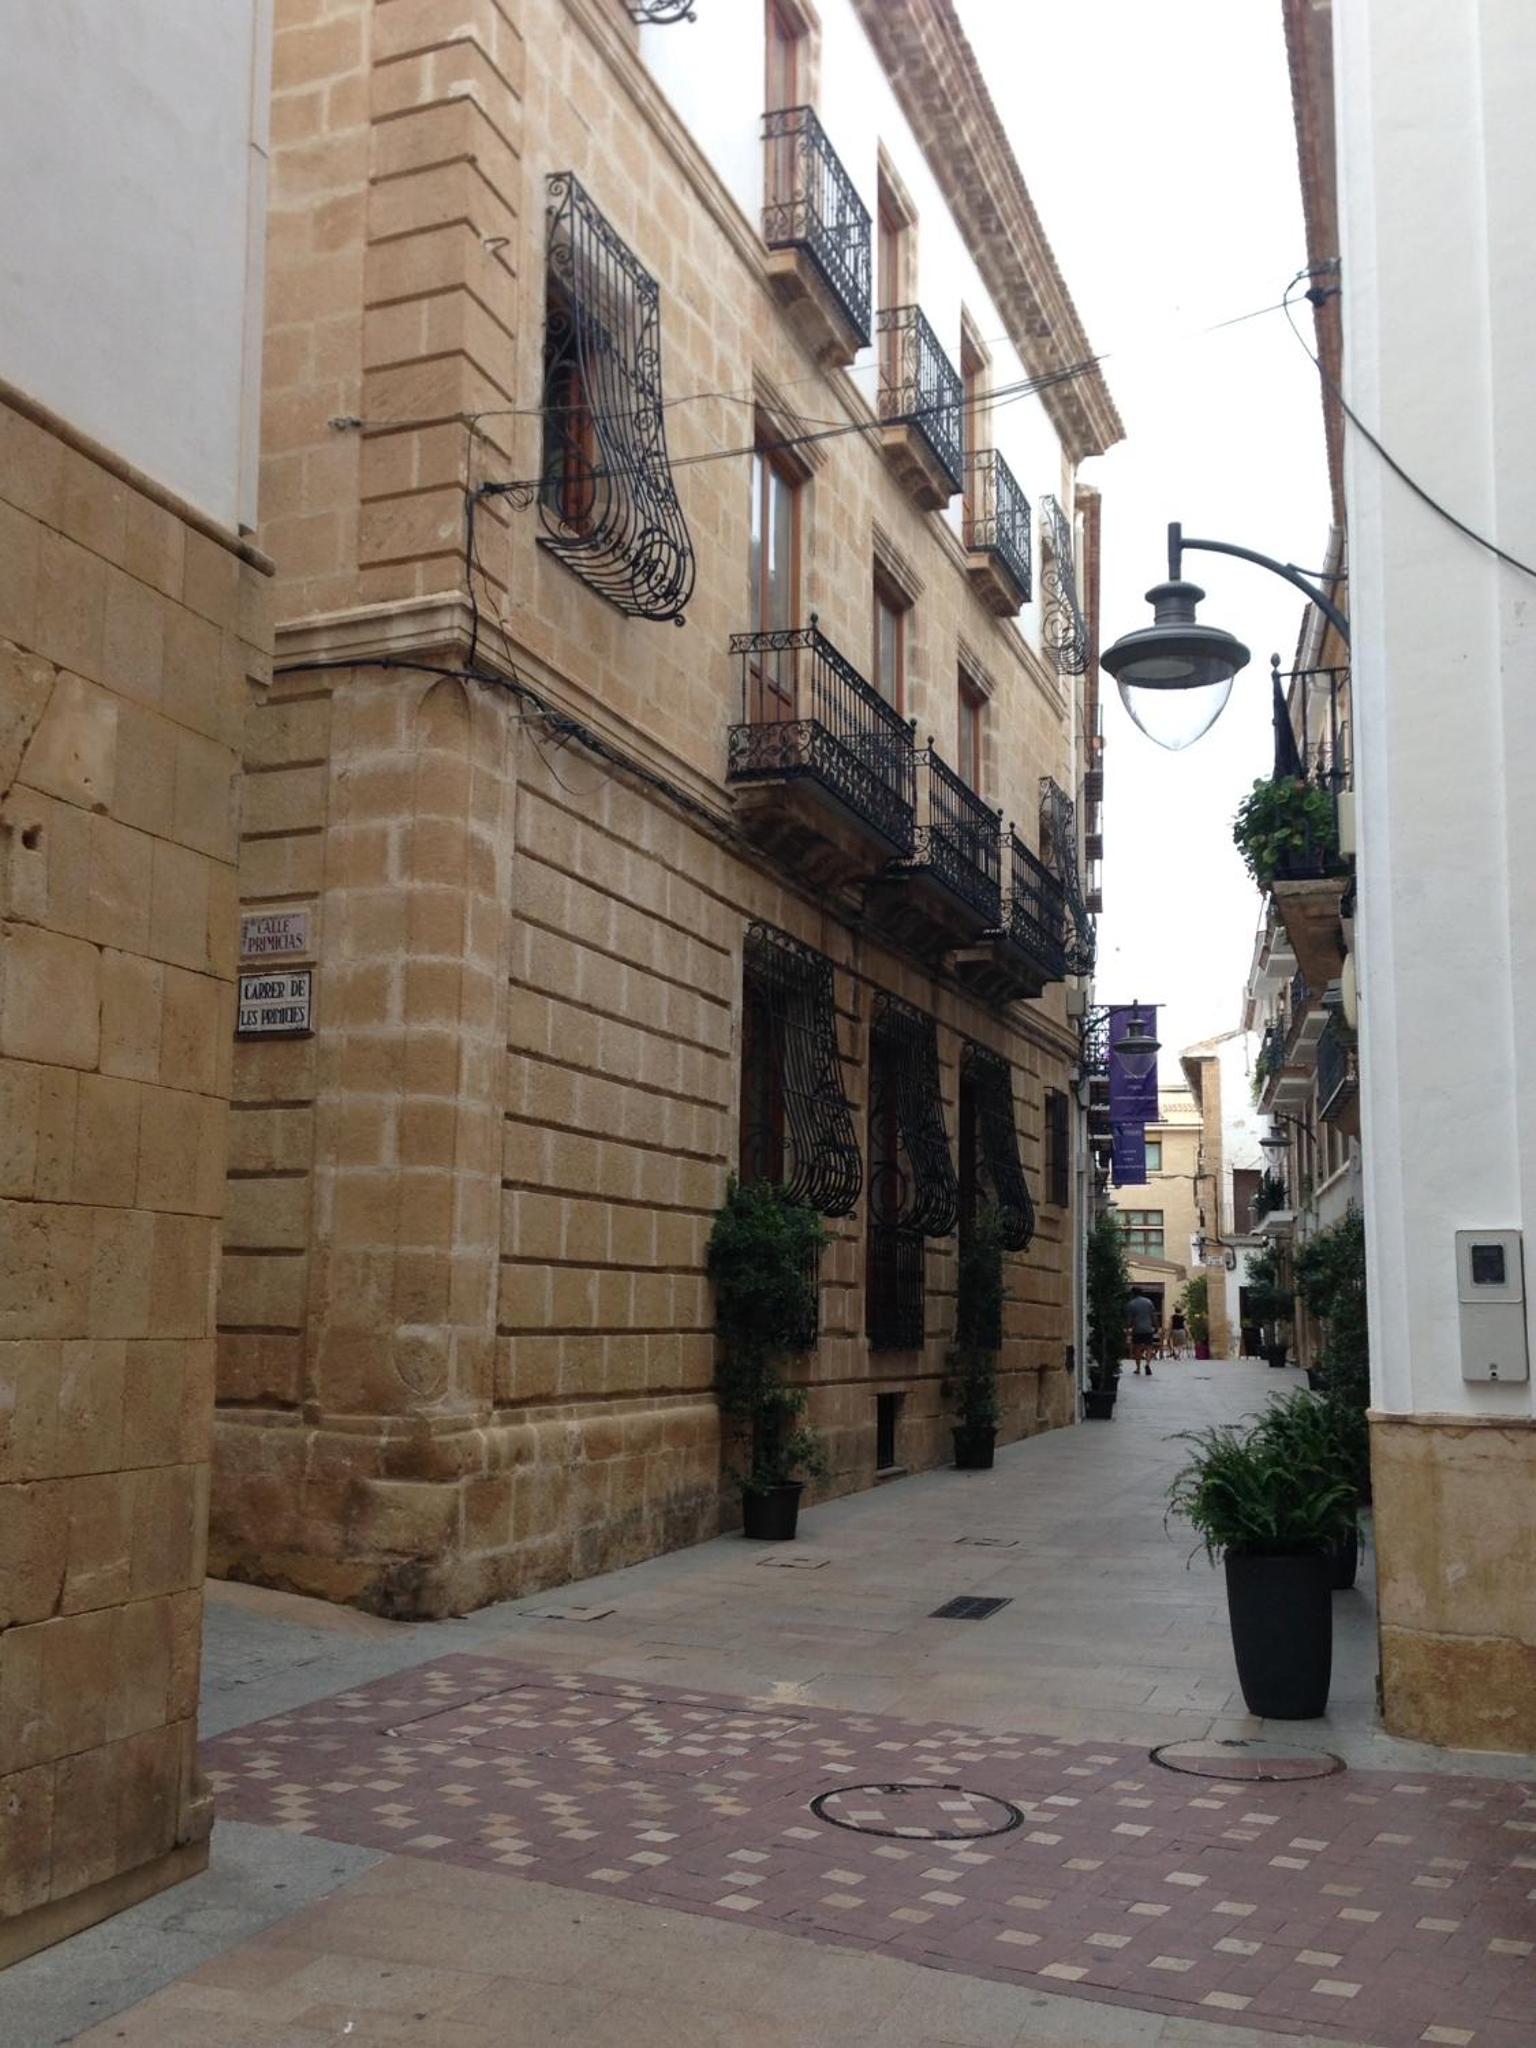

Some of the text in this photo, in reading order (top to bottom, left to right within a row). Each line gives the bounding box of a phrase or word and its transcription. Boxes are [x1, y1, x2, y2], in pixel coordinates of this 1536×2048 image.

[257, 918, 290, 934] CALLE
[247, 933, 304, 952] PRIMICIAS
[245, 979, 306, 1000] CARRER DE
[241, 1010, 258, 1026] LES
